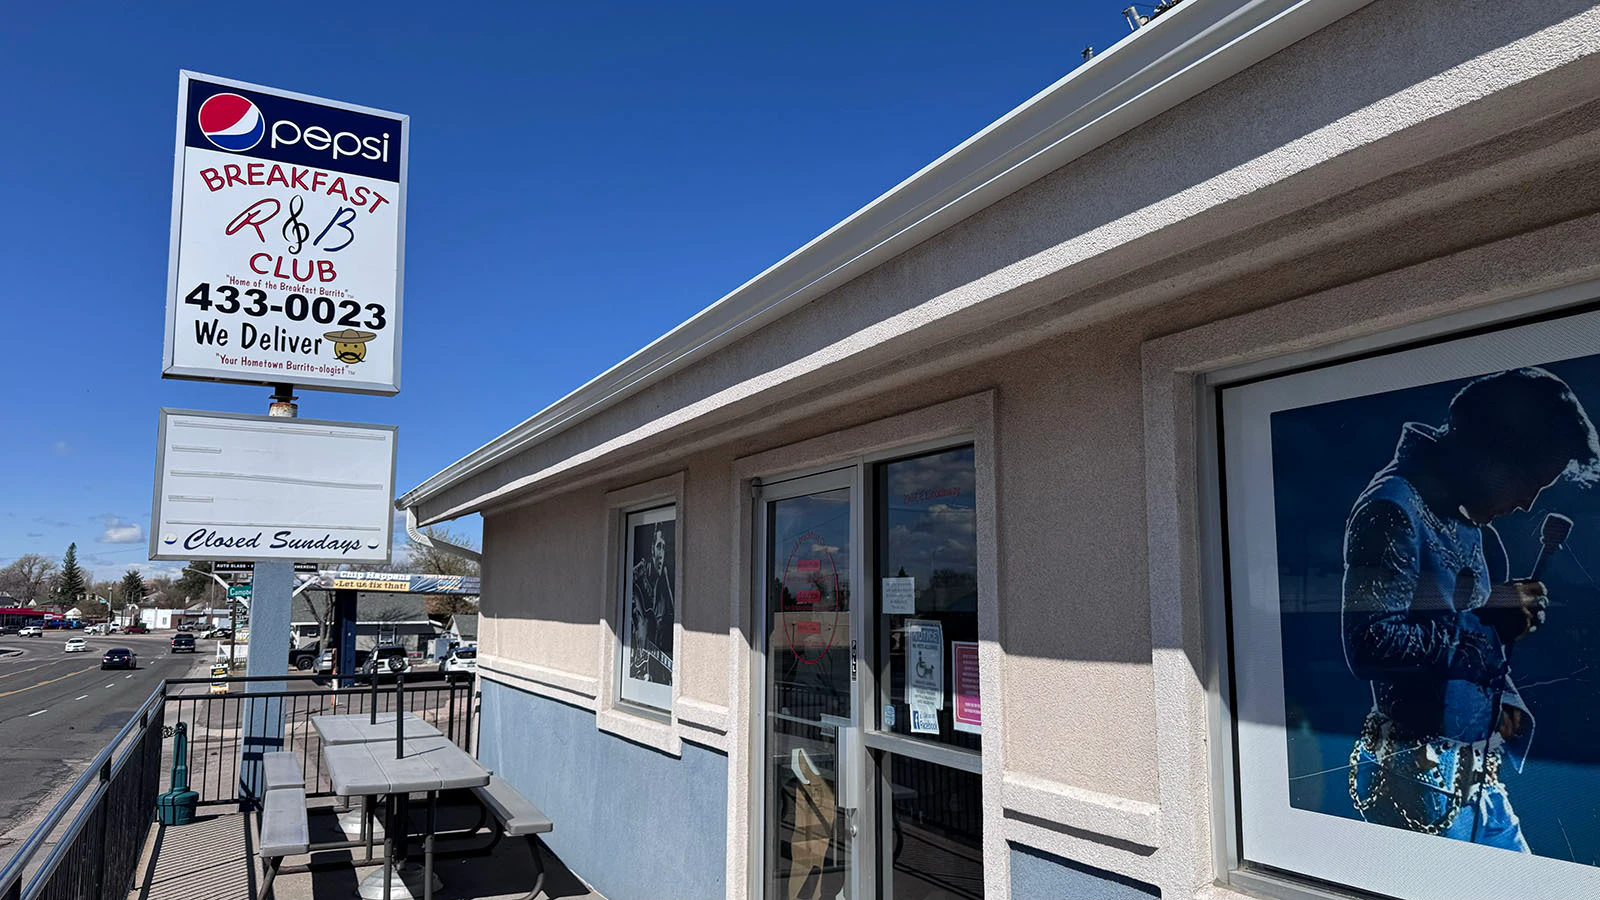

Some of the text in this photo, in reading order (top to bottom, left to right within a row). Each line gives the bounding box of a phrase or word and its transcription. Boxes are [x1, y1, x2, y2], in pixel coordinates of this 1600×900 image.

[271, 120, 390, 163] pepsi
[200, 163, 389, 214] BREAKFAST
[225, 198, 281, 243] R
[312, 206, 357, 252] B
[249, 252, 337, 283] CLUB
[226, 274, 251, 287] "Home
[253, 280, 262, 288] of
[265, 281, 277, 290] the
[280, 282, 317, 294] Breakfast
[184, 282, 387, 331] 433-0023
[195, 318, 323, 355] We Deliver
[216, 353, 238, 365] "Your
[241, 356, 284, 369] Hometown
[183, 528, 363, 555] Closed Sundays
[339, 570, 411, 581] Chip Happens
[339, 580, 354, 588] Let
[384, 582, 407, 590] that!
